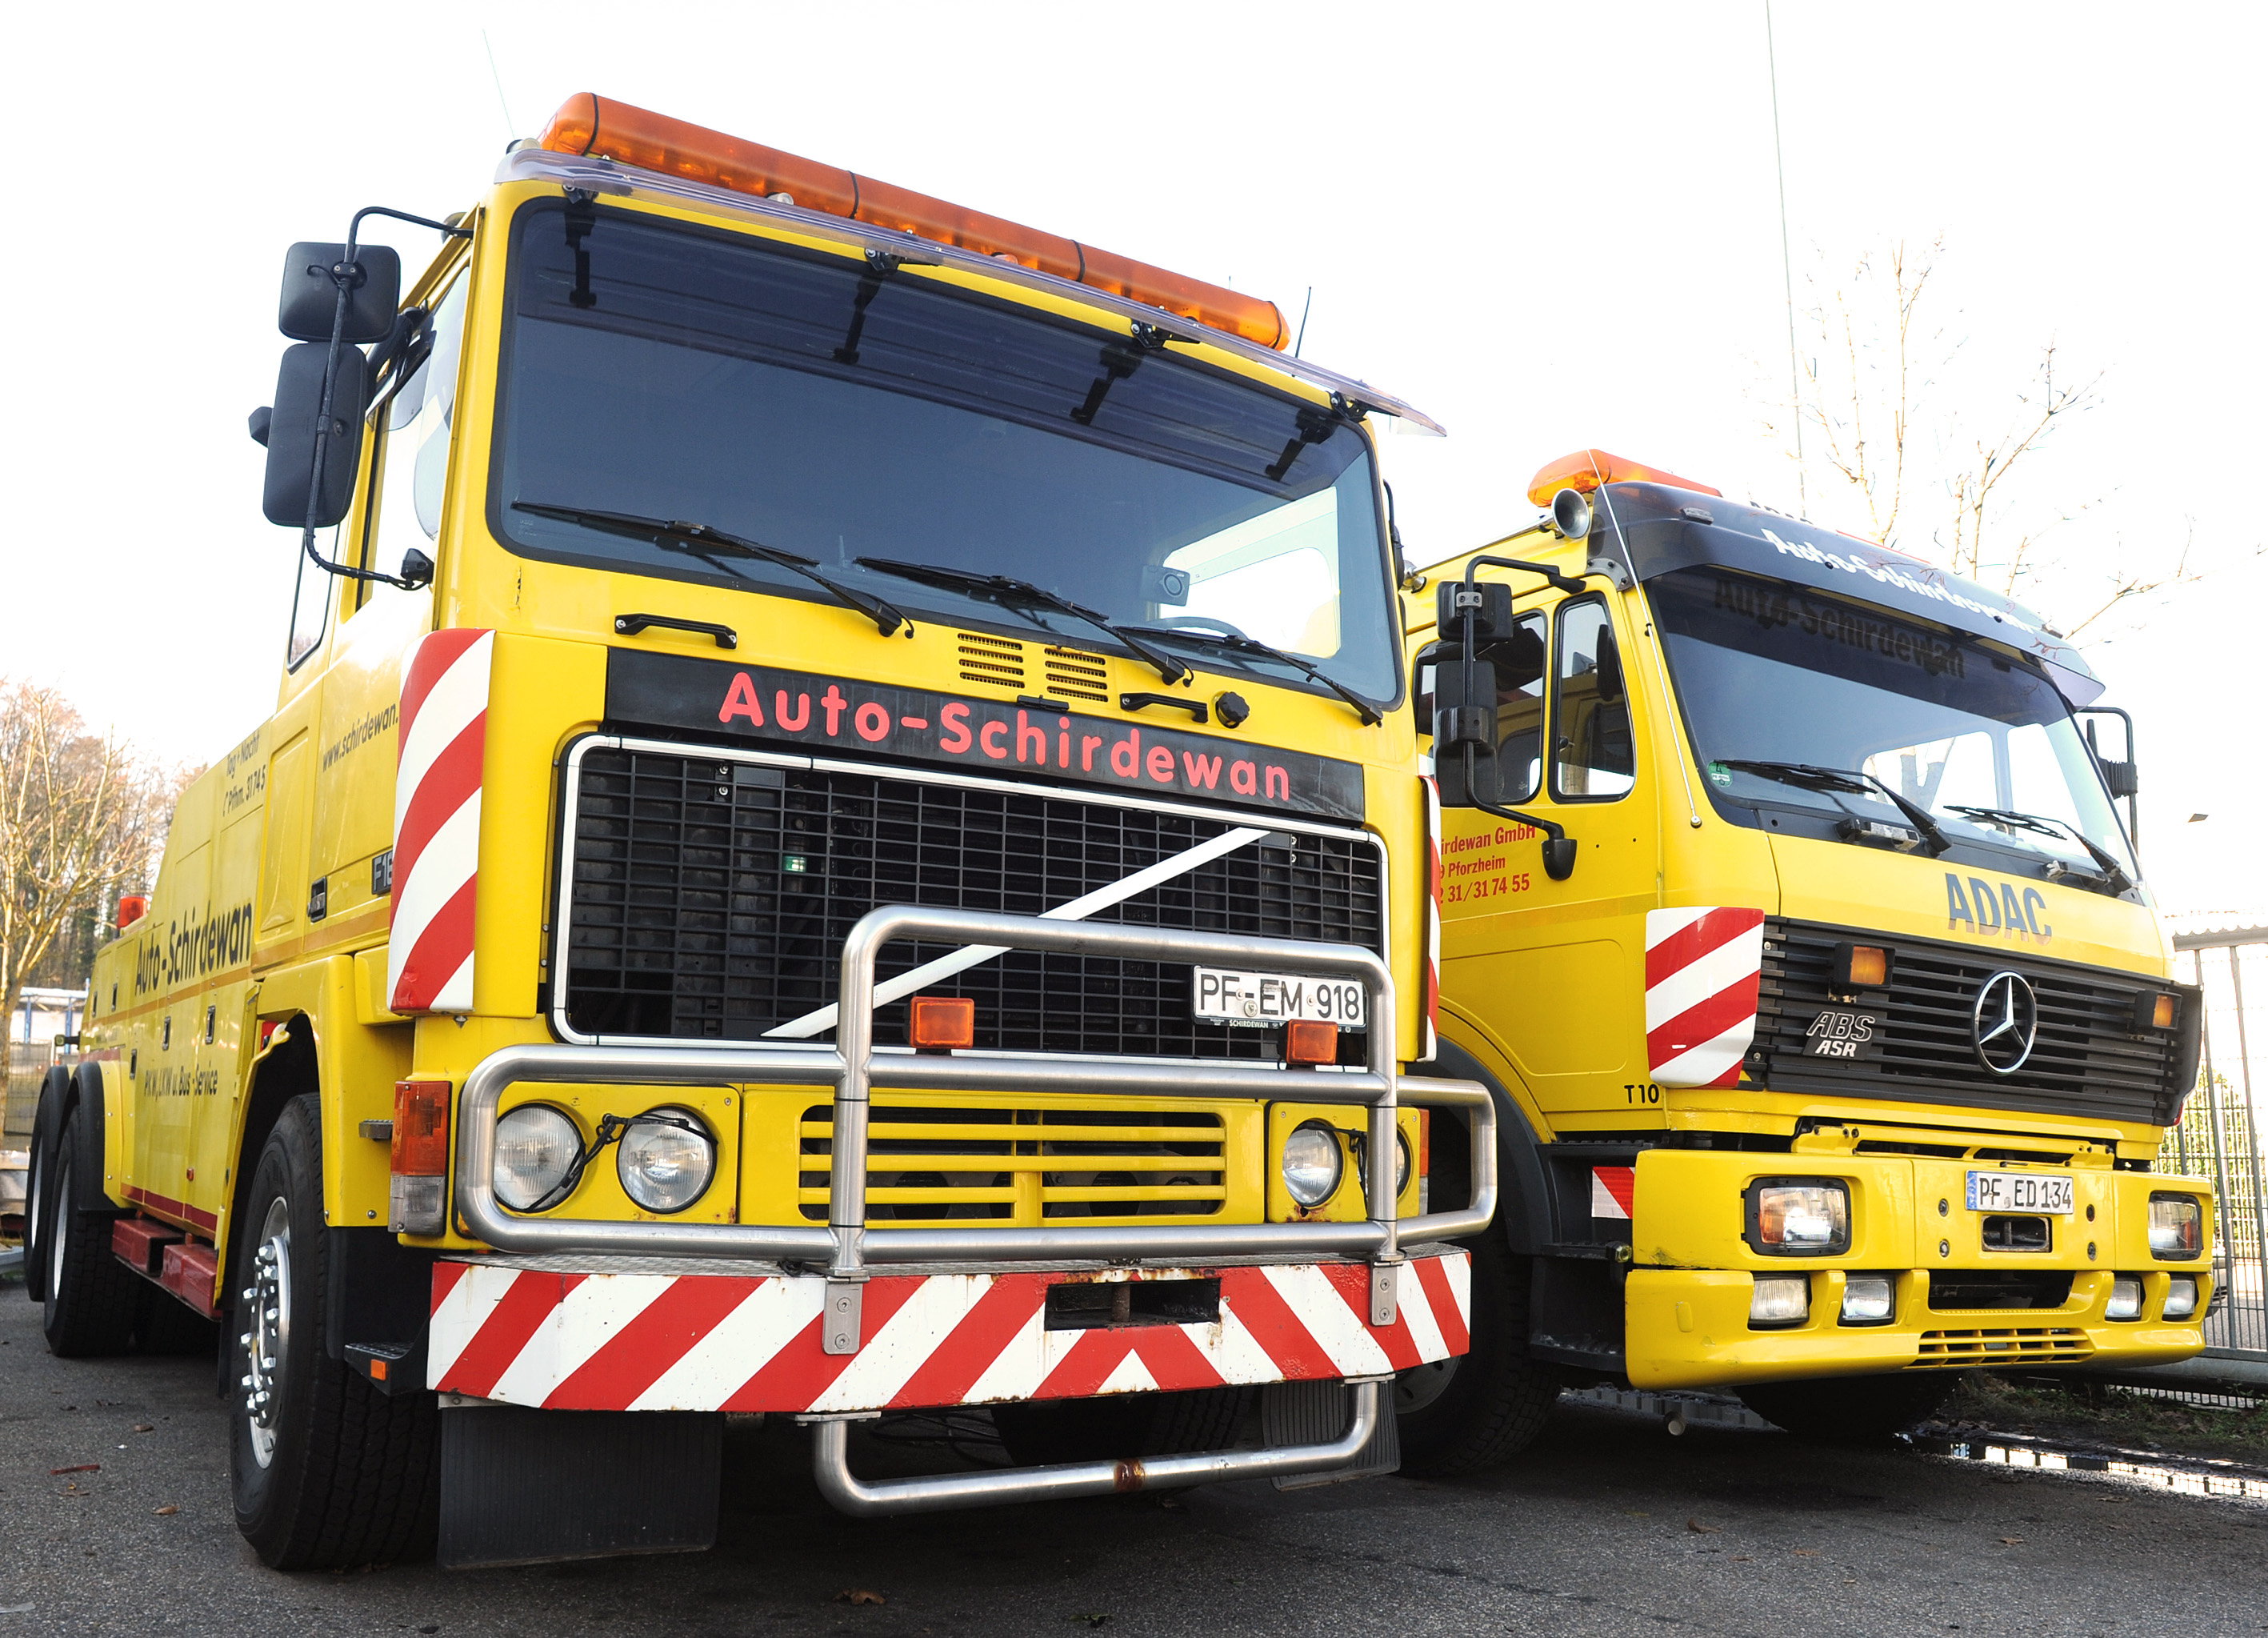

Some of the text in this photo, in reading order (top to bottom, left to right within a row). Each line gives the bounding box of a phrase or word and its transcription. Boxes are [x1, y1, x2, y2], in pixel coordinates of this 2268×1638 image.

[322, 703, 398, 772] www.schirdewan.
[718, 671, 1290, 802] Auto-Schirdewan
[1441, 823, 1536, 855] irdewan GmbH
[1448, 855, 1506, 878] Pforzheim
[1491, 876, 1508, 895] 74
[1511, 872, 1530, 892] 55
[1945, 872, 2052, 946] ADAC
[134, 899, 252, 997] Auto-Schirdewan
[1201, 973, 1360, 1020] PF-EM 918
[1229, 1019, 1269, 1029] SCHIRDEWAN
[1806, 1011, 1875, 1042] ABS
[1814, 1039, 1857, 1058] ASR
[1979, 1177, 2072, 1209] PF ED 134
